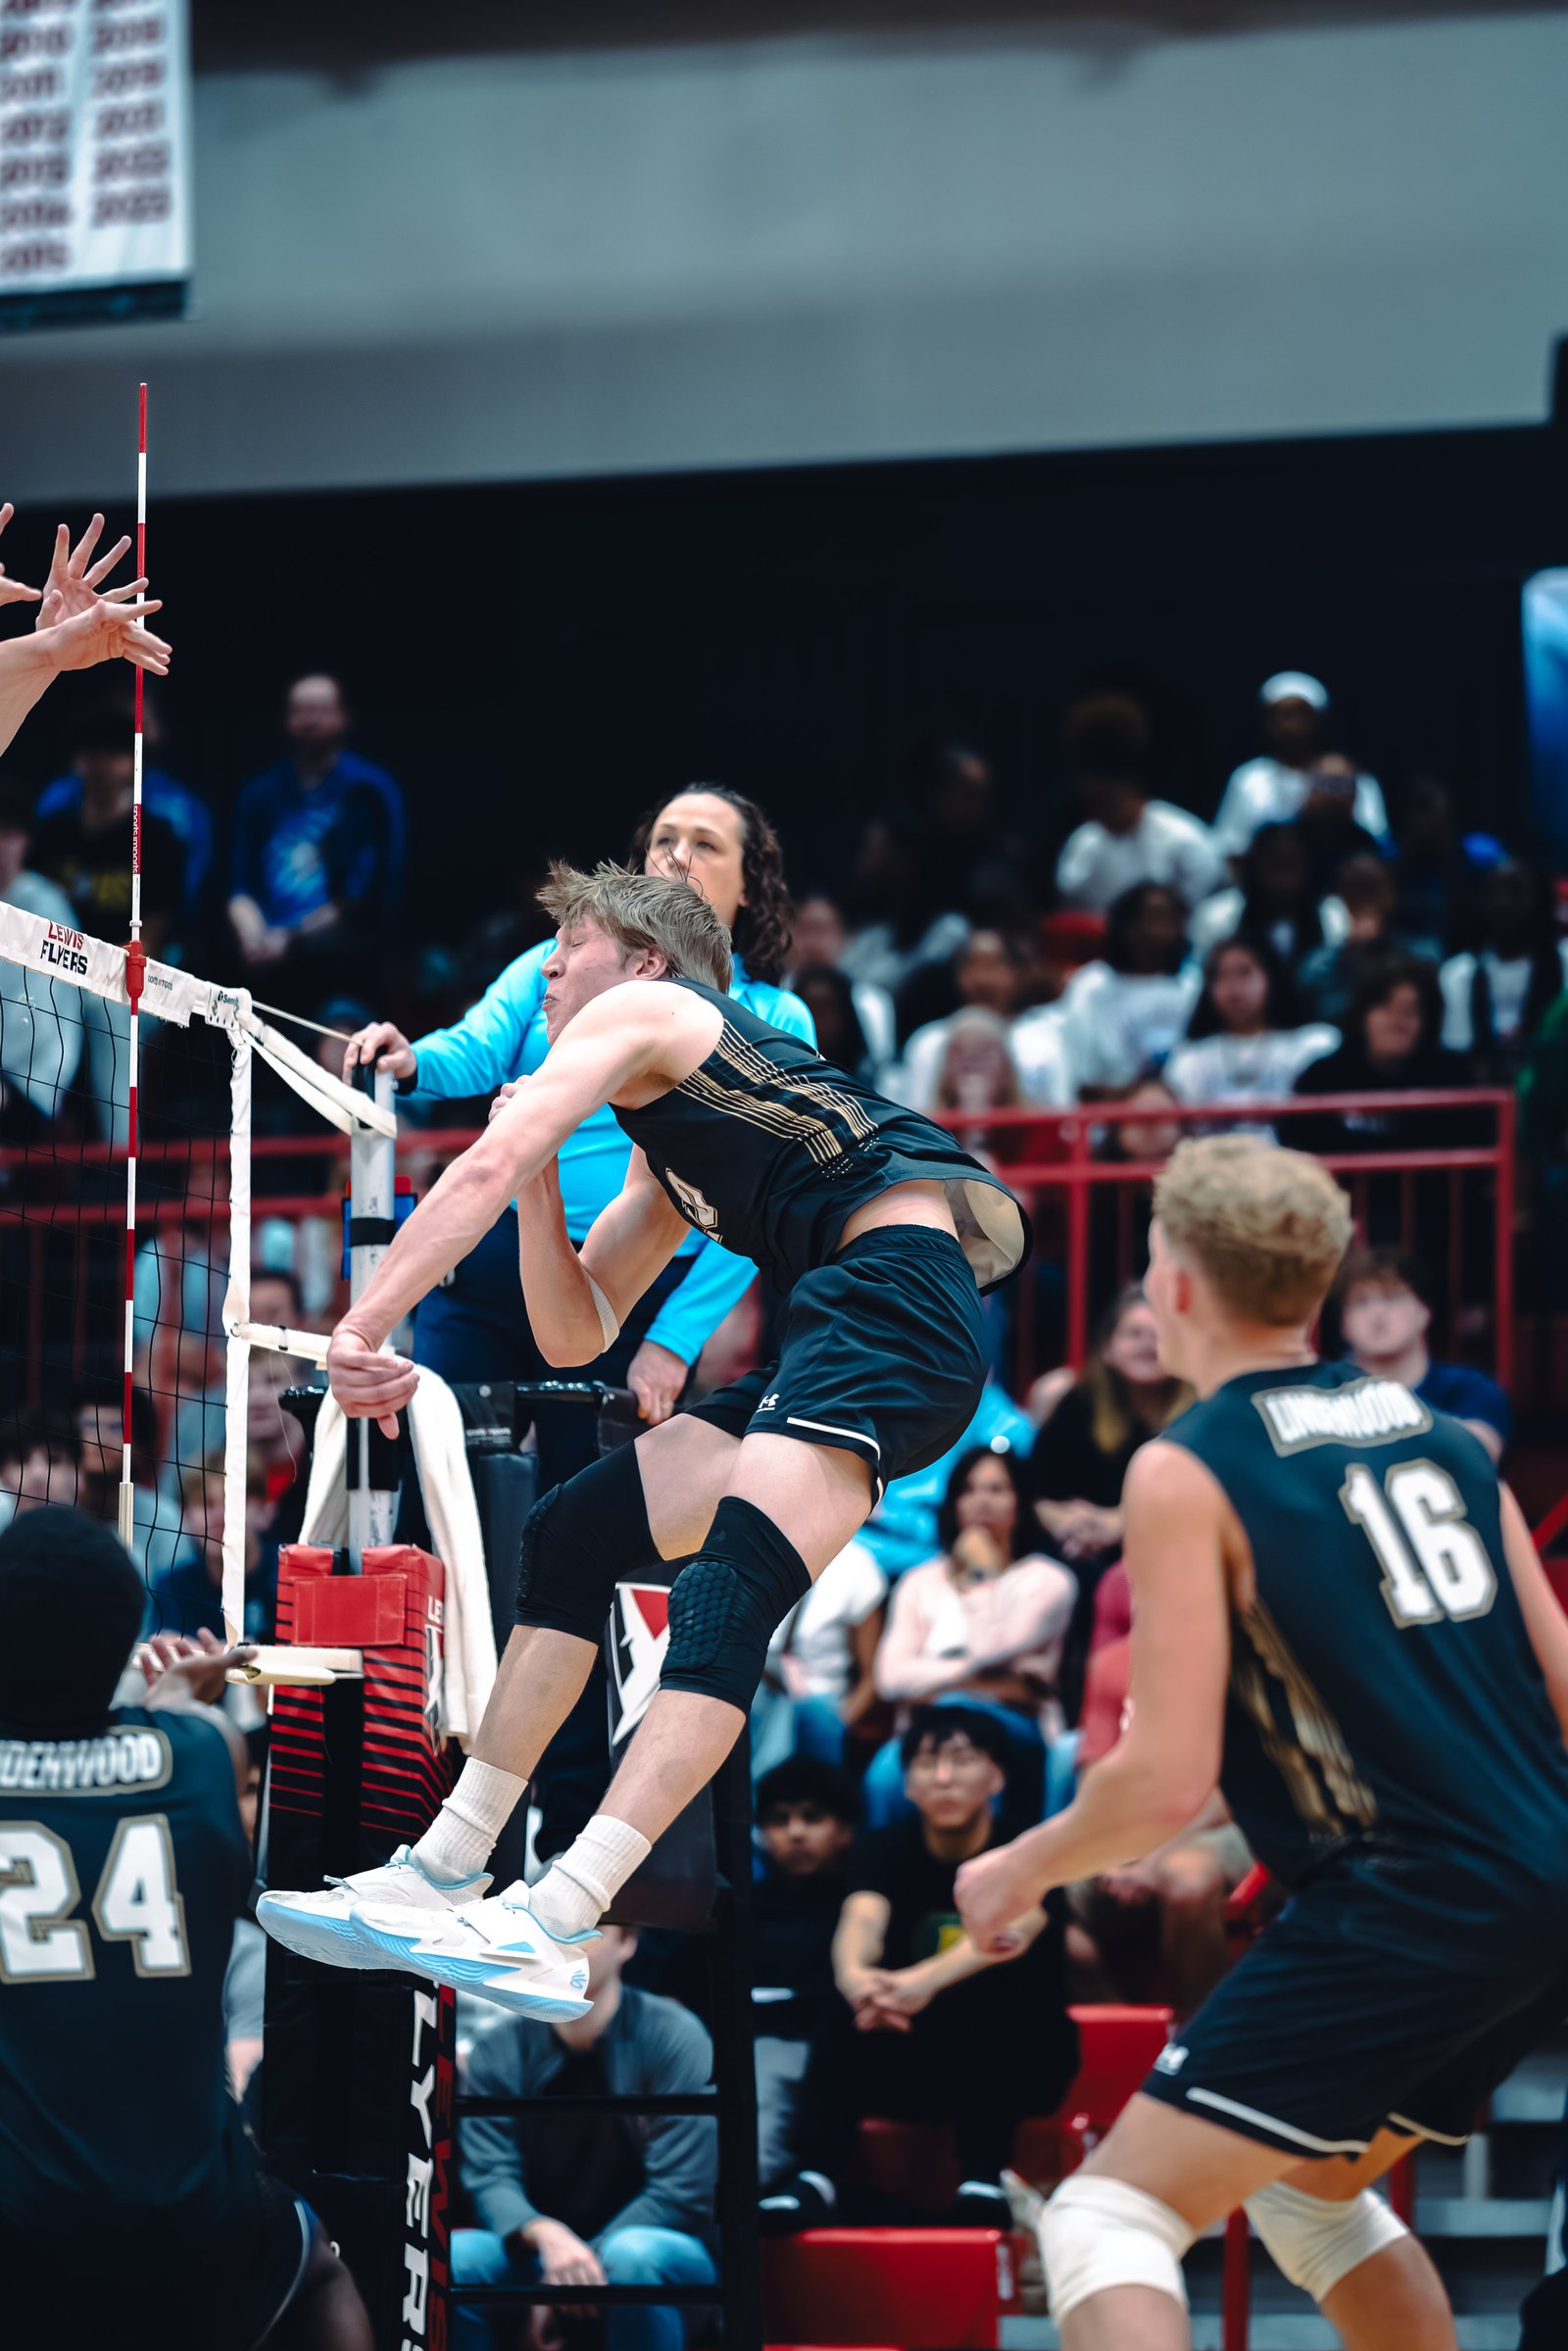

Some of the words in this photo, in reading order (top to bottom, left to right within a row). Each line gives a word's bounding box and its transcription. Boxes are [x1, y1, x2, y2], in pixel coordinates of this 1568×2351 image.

[40, 939, 88, 975] FLYERS
[48, 921, 84, 951] LEWIS
[1341, 1460, 1496, 1627] 16
[427, 1594, 444, 1624] LE
[0, 1816, 189, 1982] 24
[401, 1981, 438, 2351] LYER
